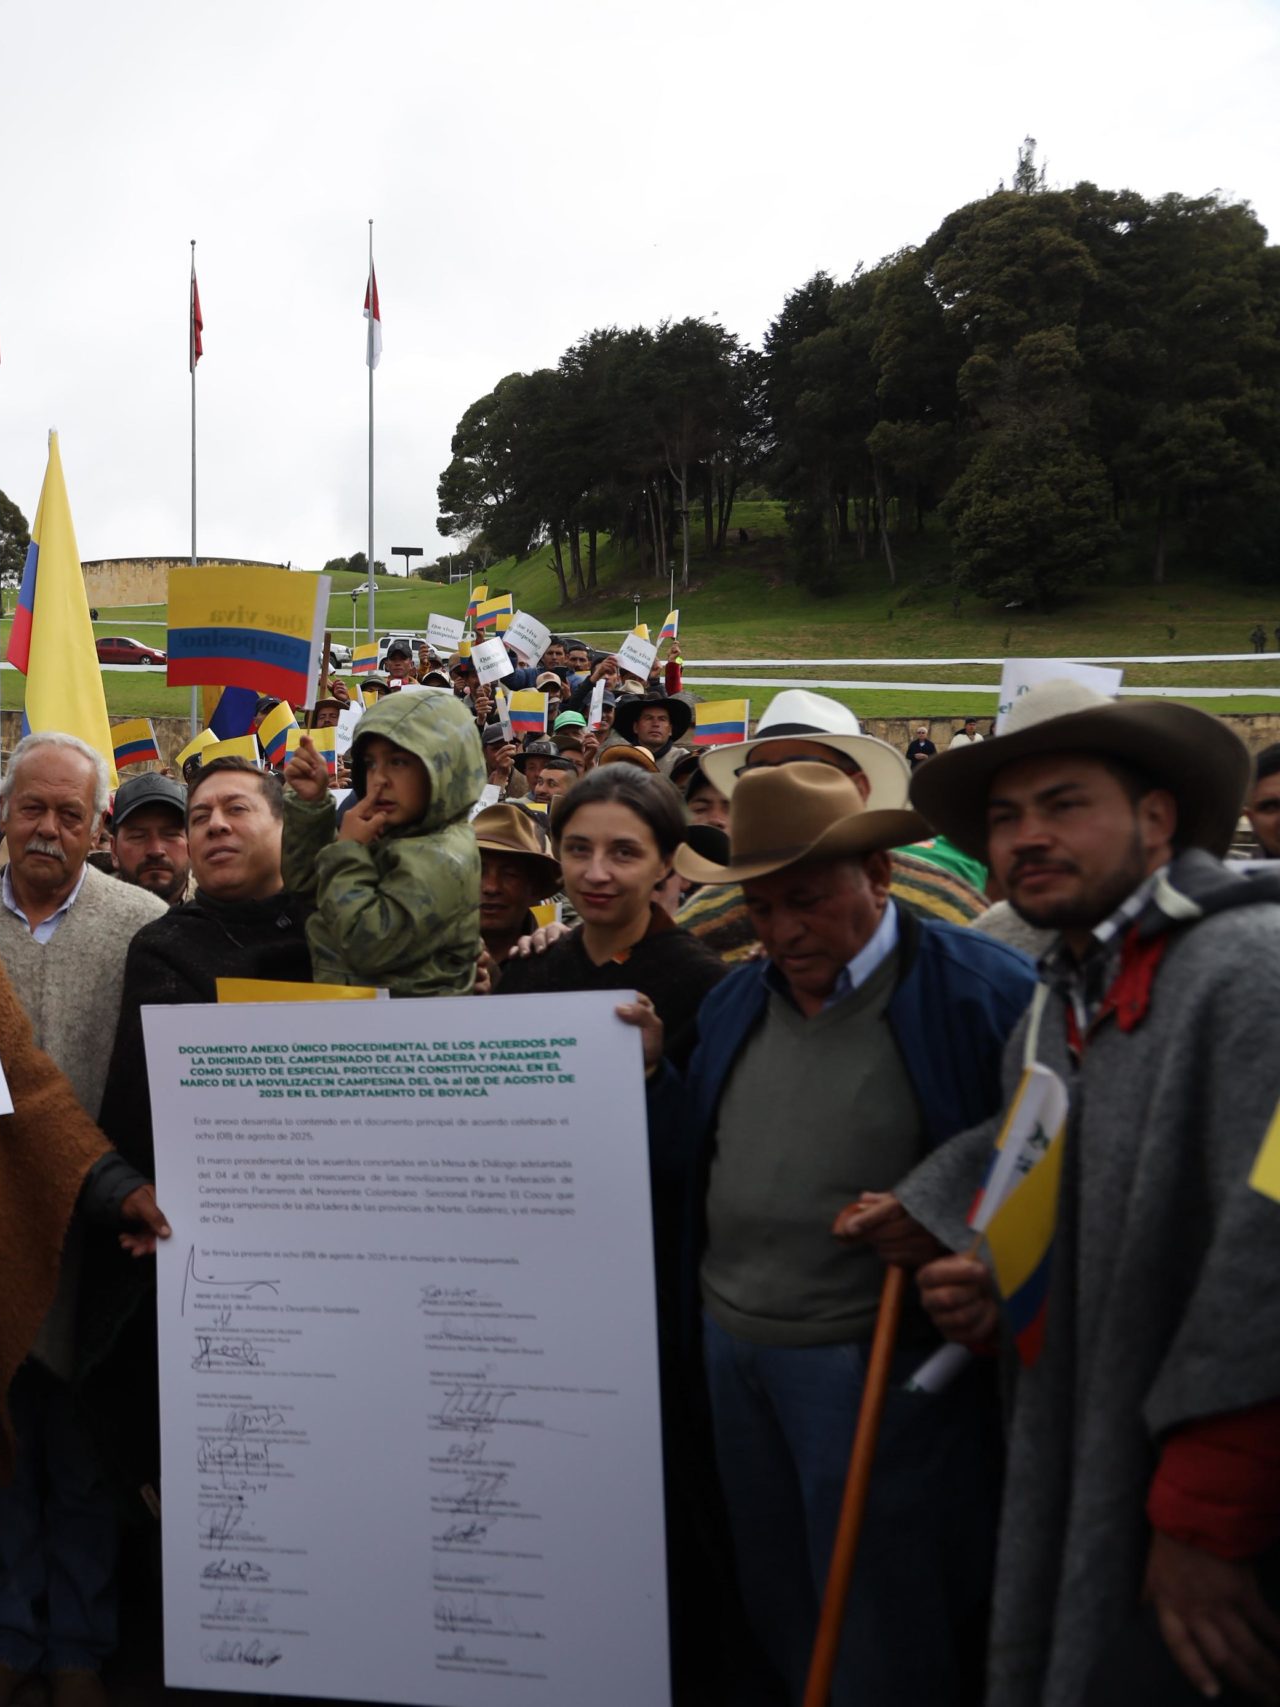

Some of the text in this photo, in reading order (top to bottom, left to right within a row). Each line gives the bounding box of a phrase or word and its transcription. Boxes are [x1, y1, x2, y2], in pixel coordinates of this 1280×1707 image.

[178, 1037, 577, 1054] DOCUMENTO ANEXO ÚNICO PROCEDIMENTAL DE LOS ACUERDOS POR
[191, 1056, 204, 1066] LA
[207, 1055, 262, 1066] DIGNIDAD
[264, 1055, 284, 1065] DEL
[288, 1053, 372, 1064] CAMPESINADO
[375, 1053, 390, 1063] DE
[394, 1052, 424, 1062] ALTA
[426, 1052, 475, 1062] LADERA
[479, 1051, 486, 1061] Y
[190, 1067, 222, 1077] COMO
[224, 1066, 266, 1076] SUJETO
[268, 1066, 284, 1076] DE
[286, 1065, 338, 1076] ESPECIAL
[417, 1063, 522, 1074] CONSTITUCIONAL
[525, 1063, 543, 1073] EN
[546, 1063, 559, 1072] EL
[180, 1078, 219, 1088] MARCO
[221, 1078, 236, 1087] DE
[238, 1078, 252, 1087] LA
[337, 1076, 404, 1086] CAMPESINA
[407, 1076, 428, 1086] DEL
[433, 1076, 448, 1085] 04
[452, 1075, 462, 1085] al
[464, 1075, 480, 1085] 08
[482, 1075, 500, 1085] DE
[503, 1074, 554, 1084] AGOSTO
[557, 1074, 575, 1084] DE
[258, 1086, 488, 1099] 2025 EN EL DEPARTAMENTO DE BOYACÁ
